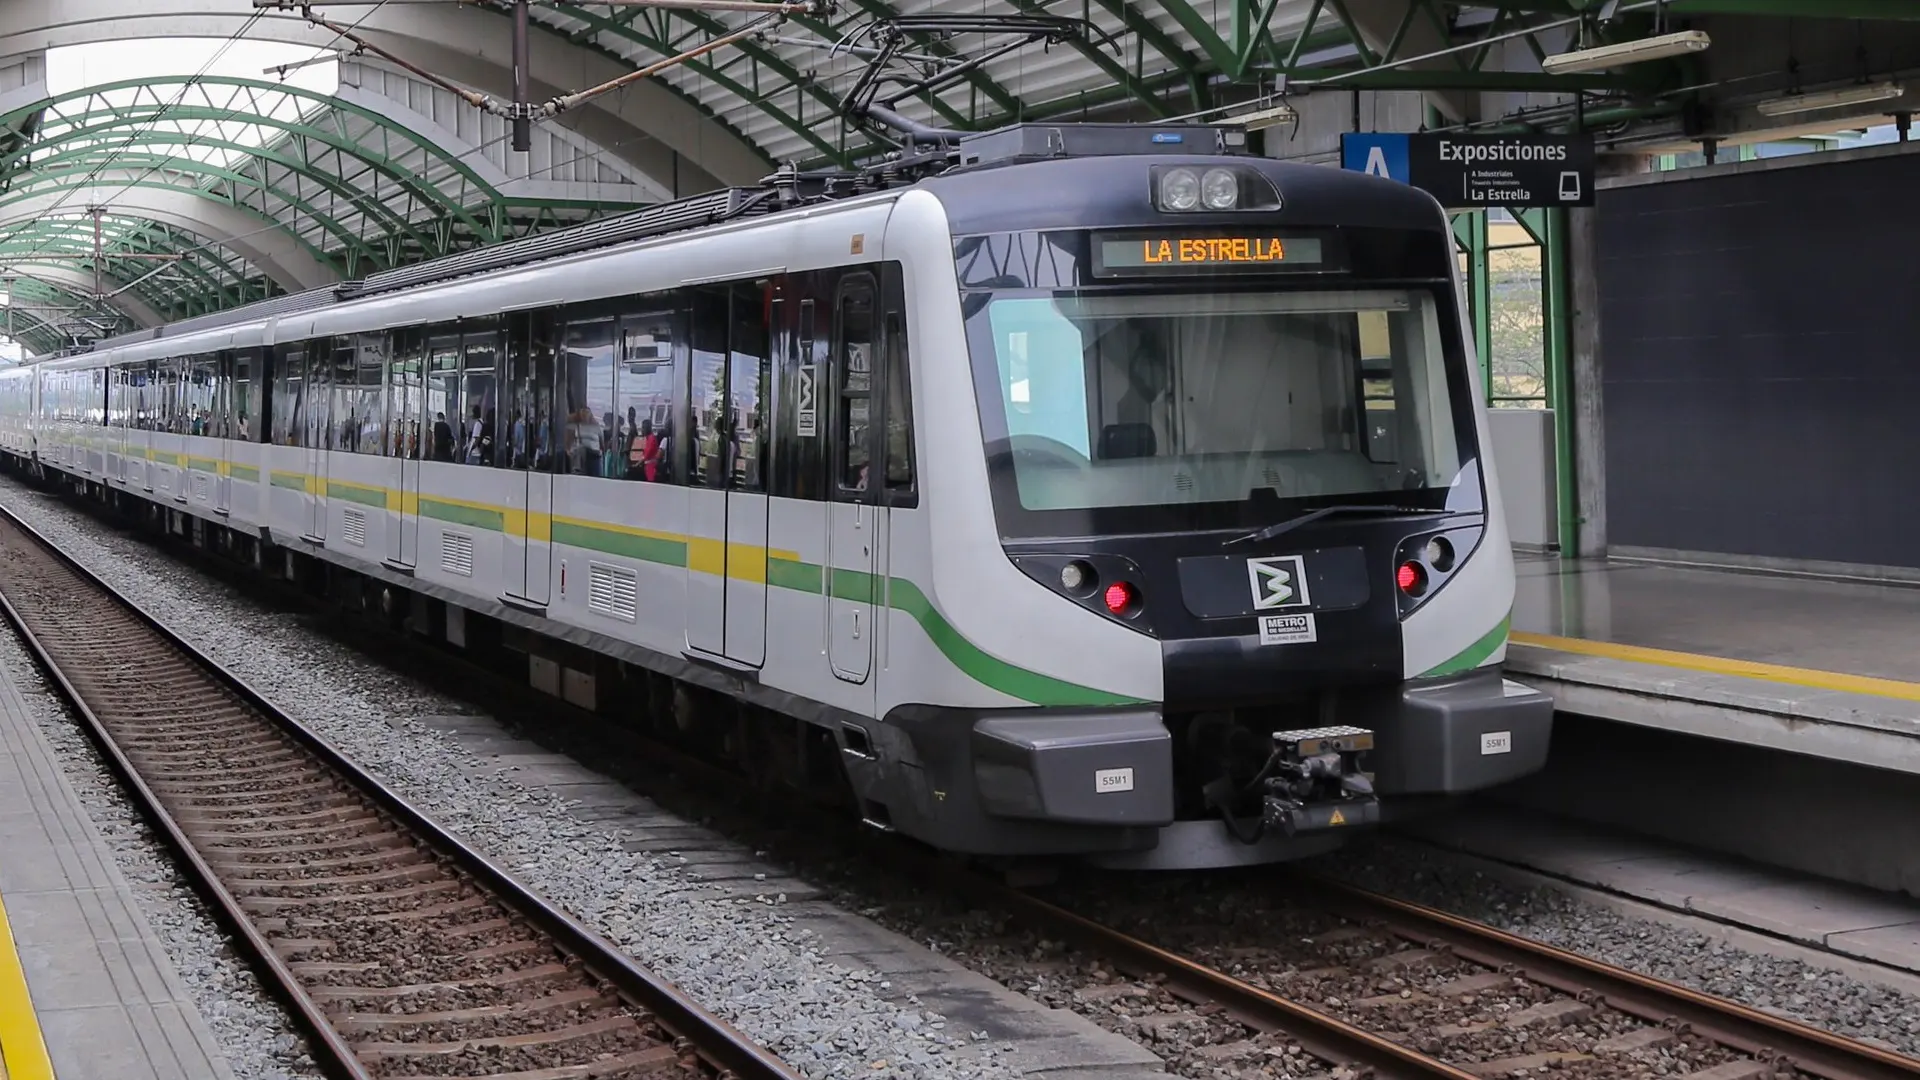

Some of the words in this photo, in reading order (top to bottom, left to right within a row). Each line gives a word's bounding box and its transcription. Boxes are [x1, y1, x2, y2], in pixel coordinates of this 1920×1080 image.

[1365, 146, 1390, 179] A
[1439, 140, 1566, 165] Exposiciones
[1472, 188, 1484, 200] La
[1487, 188, 1530, 200] Estrella
[1143, 239, 1172, 262] LA
[1179, 238, 1284, 262] ESTRELLA
[1268, 617, 1306, 628] METRO
